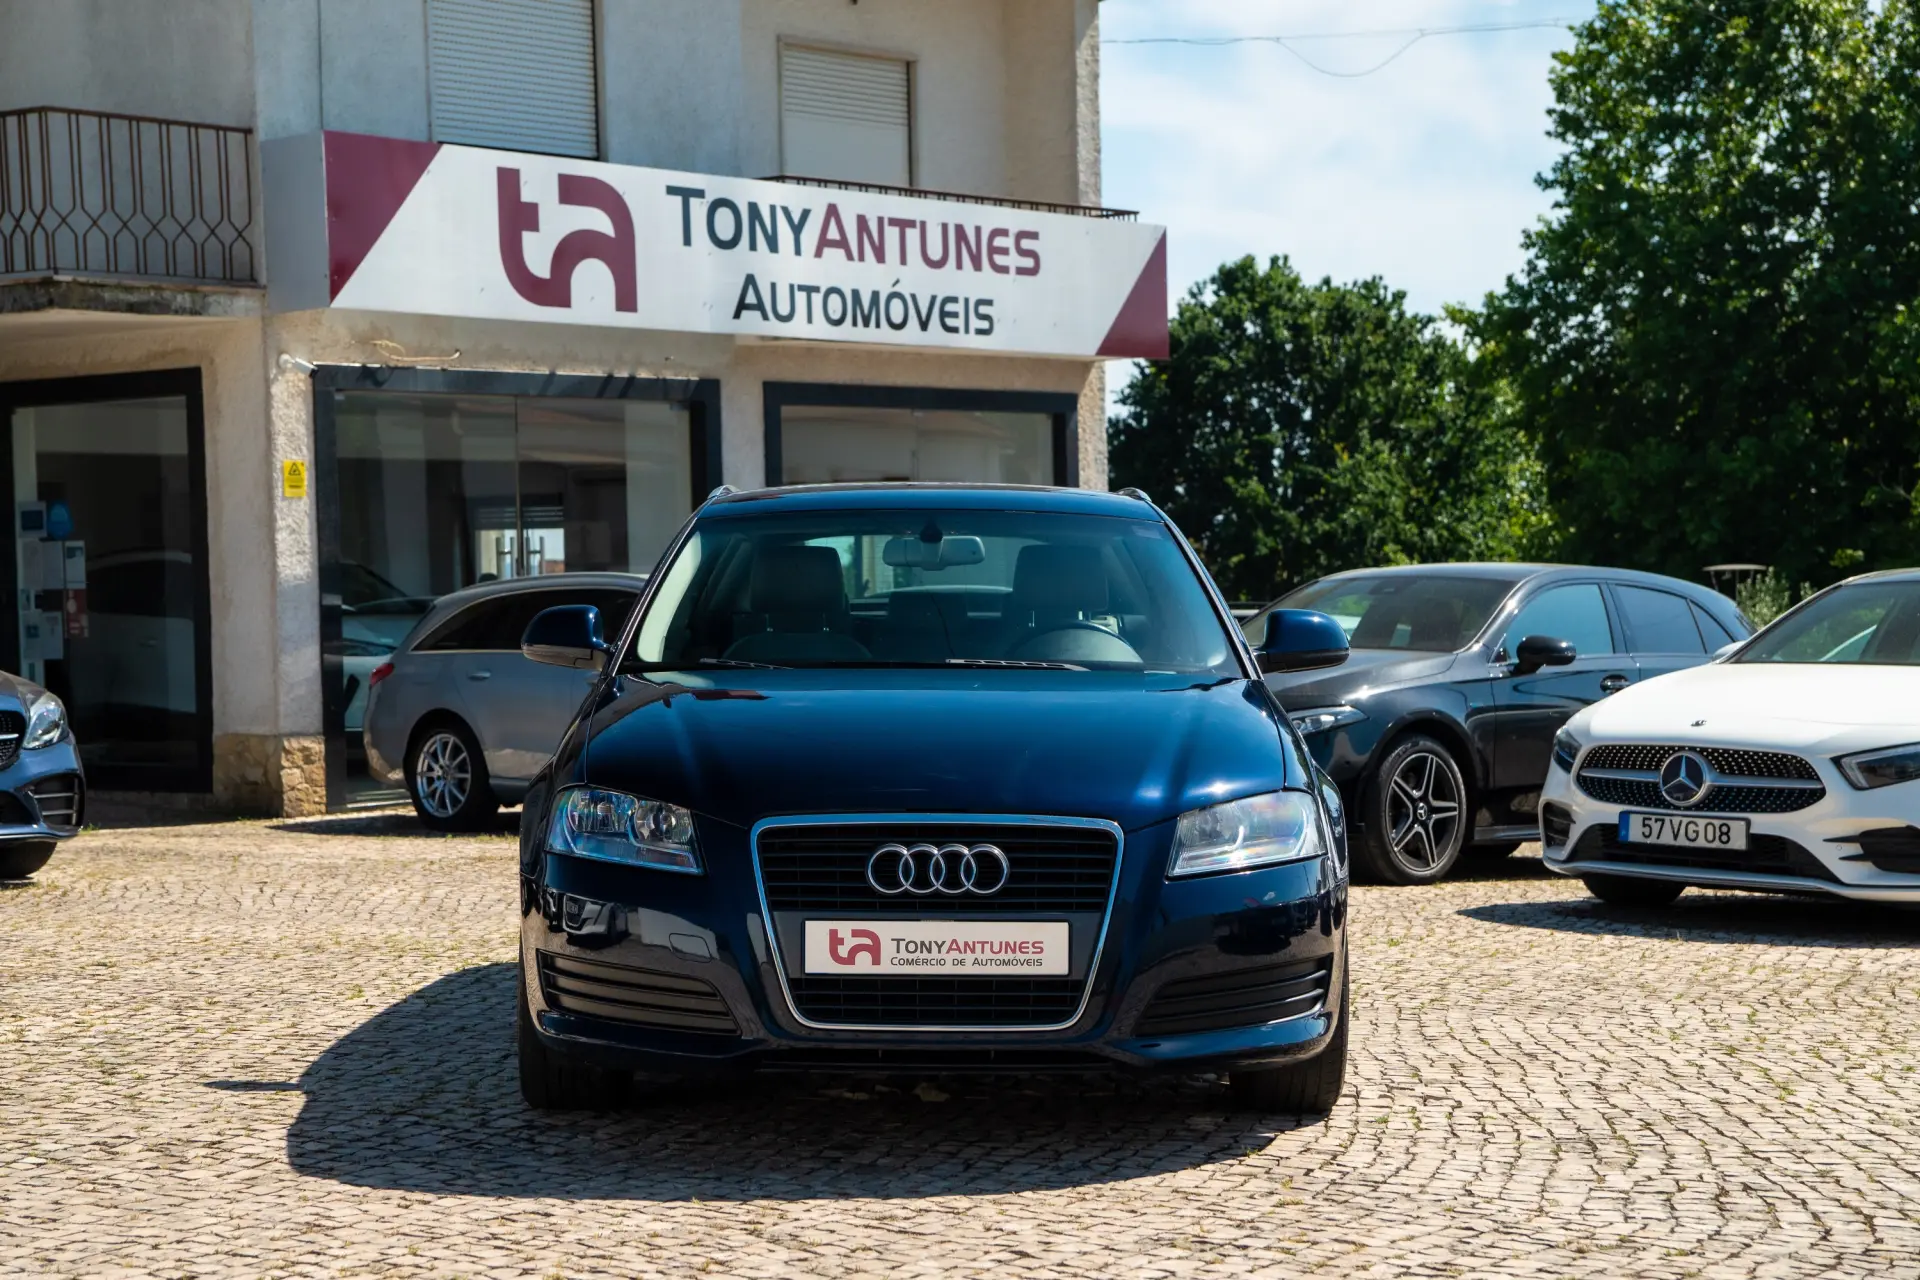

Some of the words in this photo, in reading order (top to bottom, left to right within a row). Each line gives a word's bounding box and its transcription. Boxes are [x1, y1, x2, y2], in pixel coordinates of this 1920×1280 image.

[732, 273, 995, 336] AUTOMÓVEIS
[890, 956, 947, 967] COMÉRCIO
[952, 958, 967, 967] DE
[972, 956, 1043, 967] AUTOMÓVEIS
